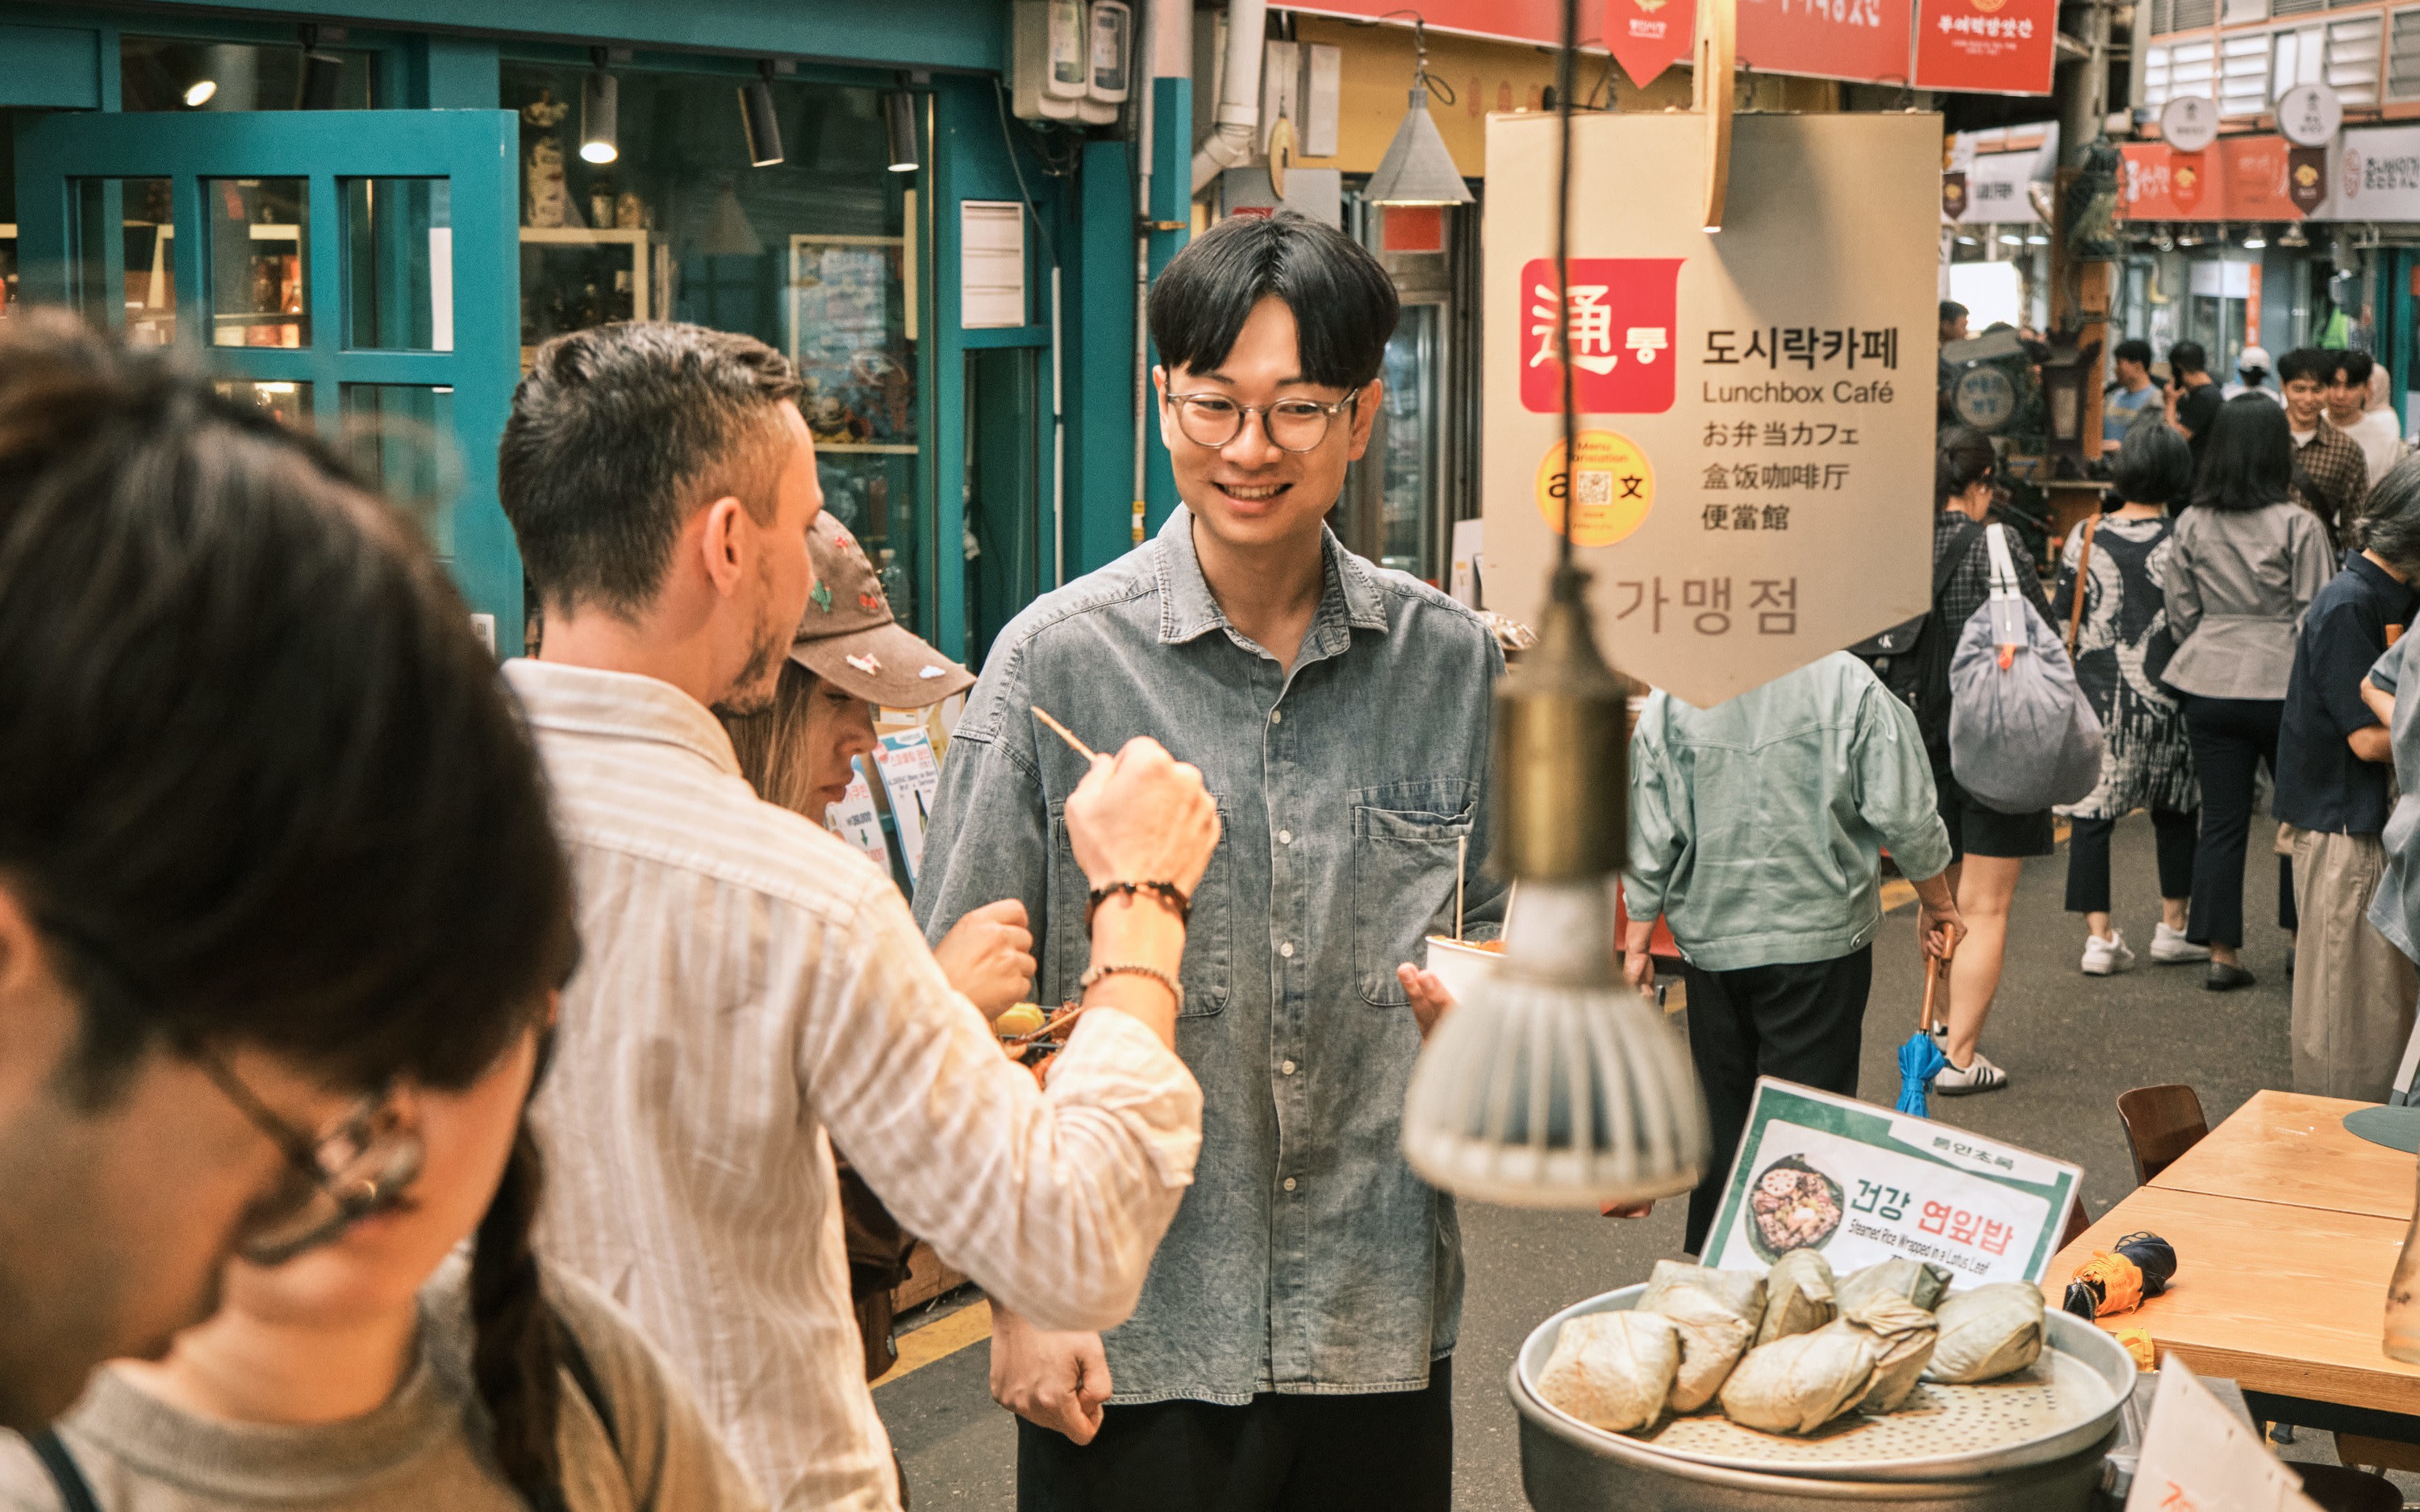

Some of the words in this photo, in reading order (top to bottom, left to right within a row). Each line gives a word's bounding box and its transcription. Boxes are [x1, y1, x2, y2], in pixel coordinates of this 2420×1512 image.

[1938, 15, 2034, 39] 부여떡방앗간
[1529, 284, 1617, 375] 通
[1625, 327, 1667, 364] 통
[1703, 327, 1897, 369] 도시락카페
[1703, 381, 1823, 403] Lunchbox
[1834, 381, 1893, 403] Café
[1702, 421, 1859, 447] お弁当カフェ
[1702, 463, 1850, 490] 盒饭咖啡厅
[1701, 504, 1790, 531] 便當館
[1617, 577, 1796, 635] 가맹점
[1851, 1179, 1911, 1221] 건강
[1917, 1200, 2013, 1256] 연잎밥
[1848, 1218, 1880, 1240] Steamed
[1880, 1227, 1897, 1246] Rice
[1898, 1234, 1931, 1257] Wrapped
[1931, 1245, 1939, 1258] in
[1946, 1249, 1968, 1269] Lotus
[1968, 1257, 1991, 1276] Leaf
